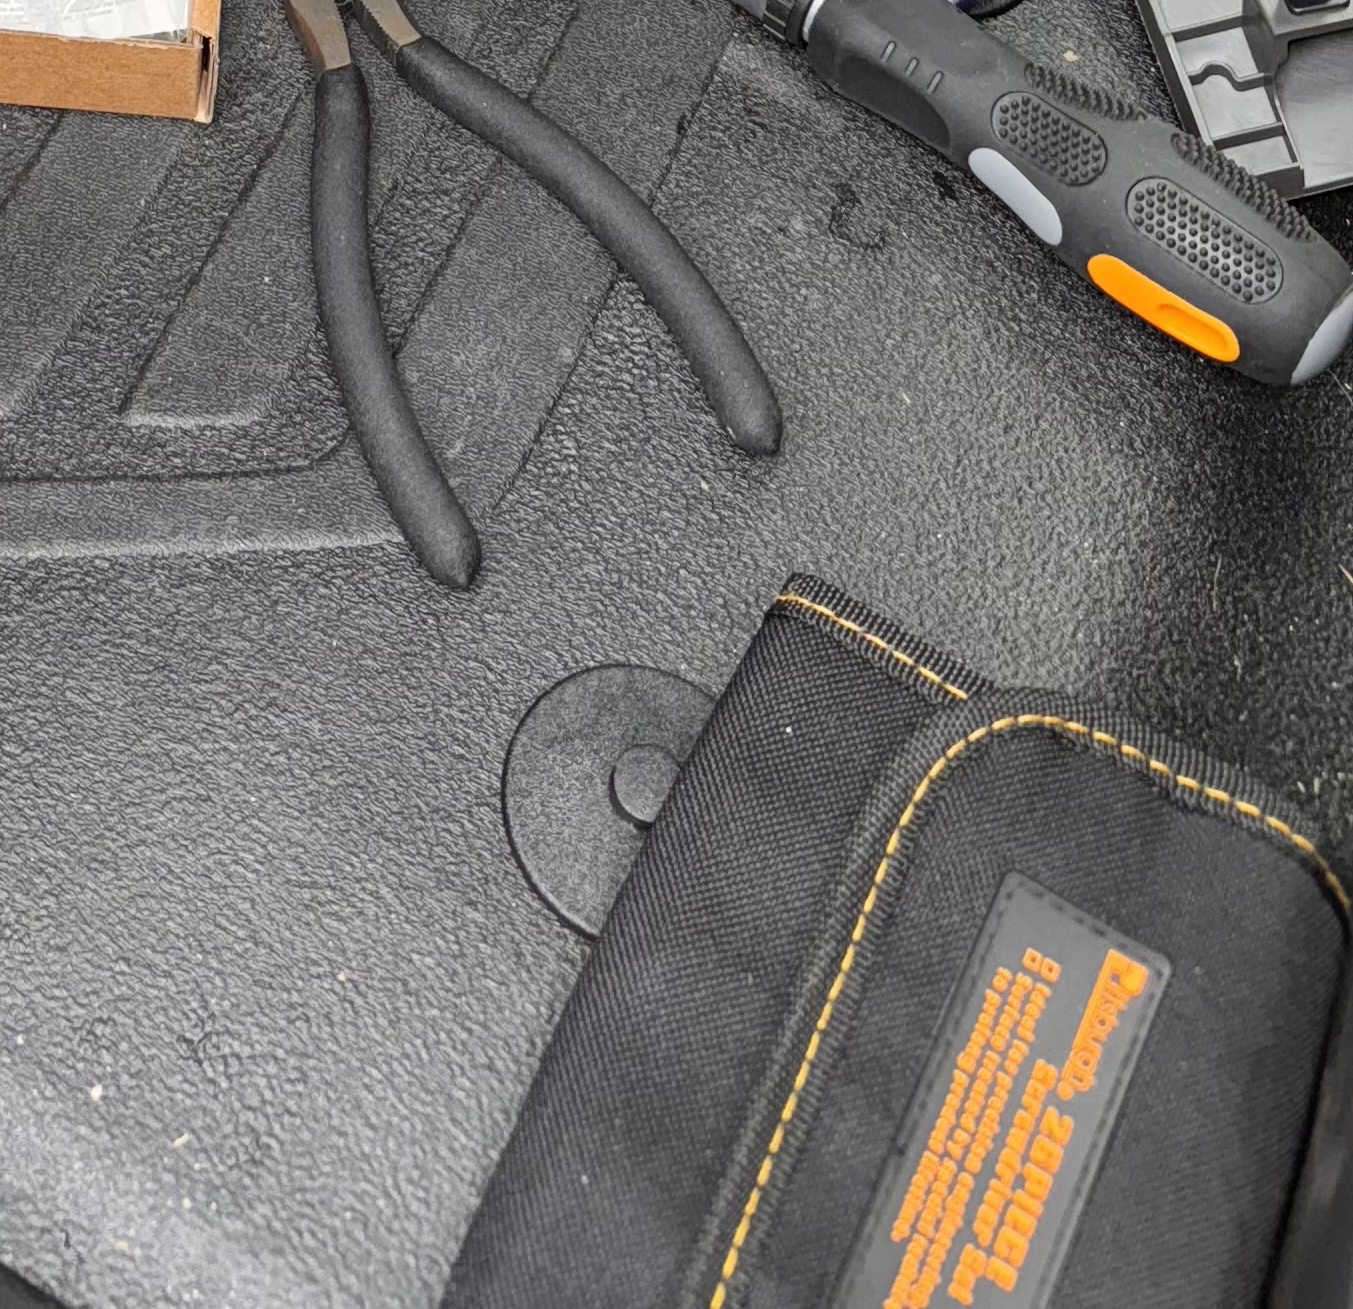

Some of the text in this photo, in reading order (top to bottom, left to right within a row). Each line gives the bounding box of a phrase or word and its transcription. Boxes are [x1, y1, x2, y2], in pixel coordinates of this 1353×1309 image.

[989, 973, 1032, 1053] Surface
[1016, 984, 1048, 1042] Ideal
[948, 1059, 1057, 1305] Screwdriver Set
